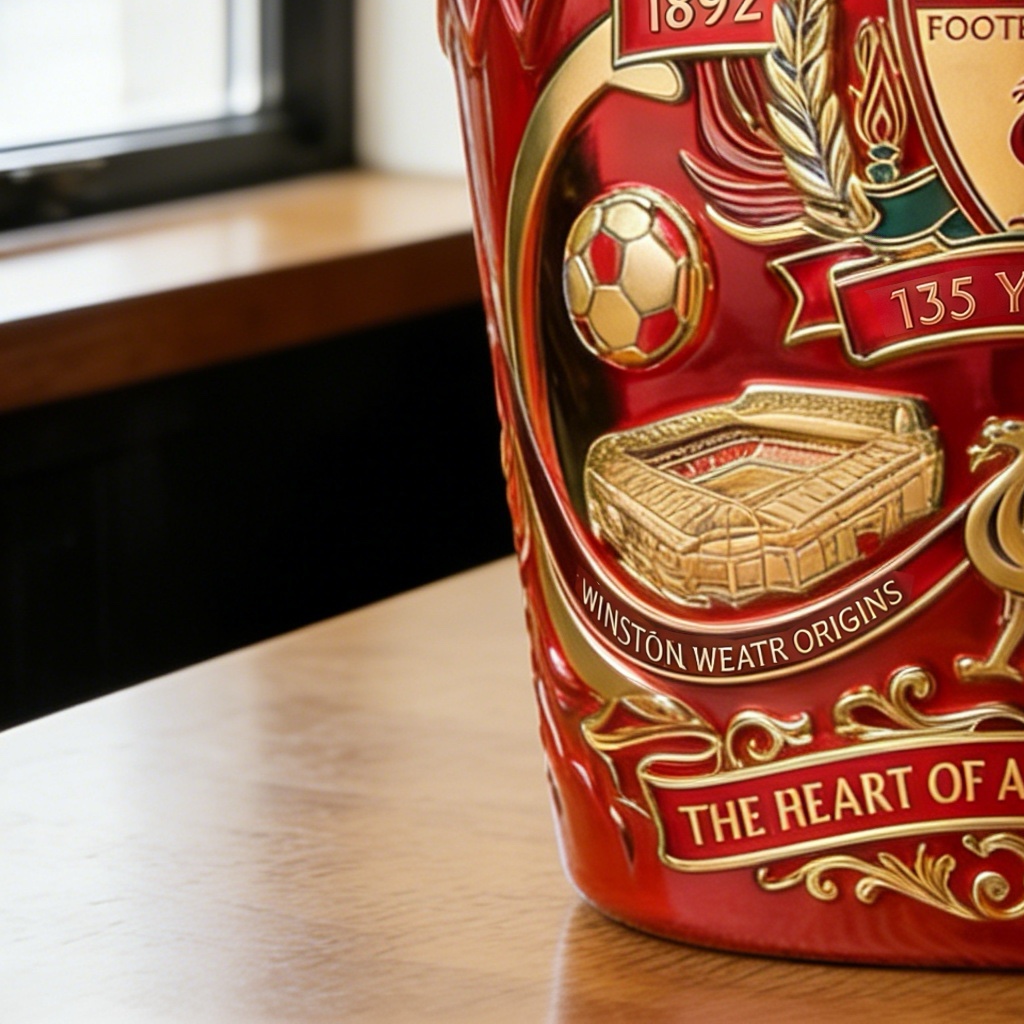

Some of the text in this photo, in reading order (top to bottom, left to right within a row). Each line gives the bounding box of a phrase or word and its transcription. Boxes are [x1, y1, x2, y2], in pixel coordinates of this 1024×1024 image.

[890, 276, 976, 330] 135
[692, 637, 790, 673] WEATR
[793, 579, 904, 655] ORIGINS
[678, 796, 766, 845] THE
[928, 760, 986, 805] OF
